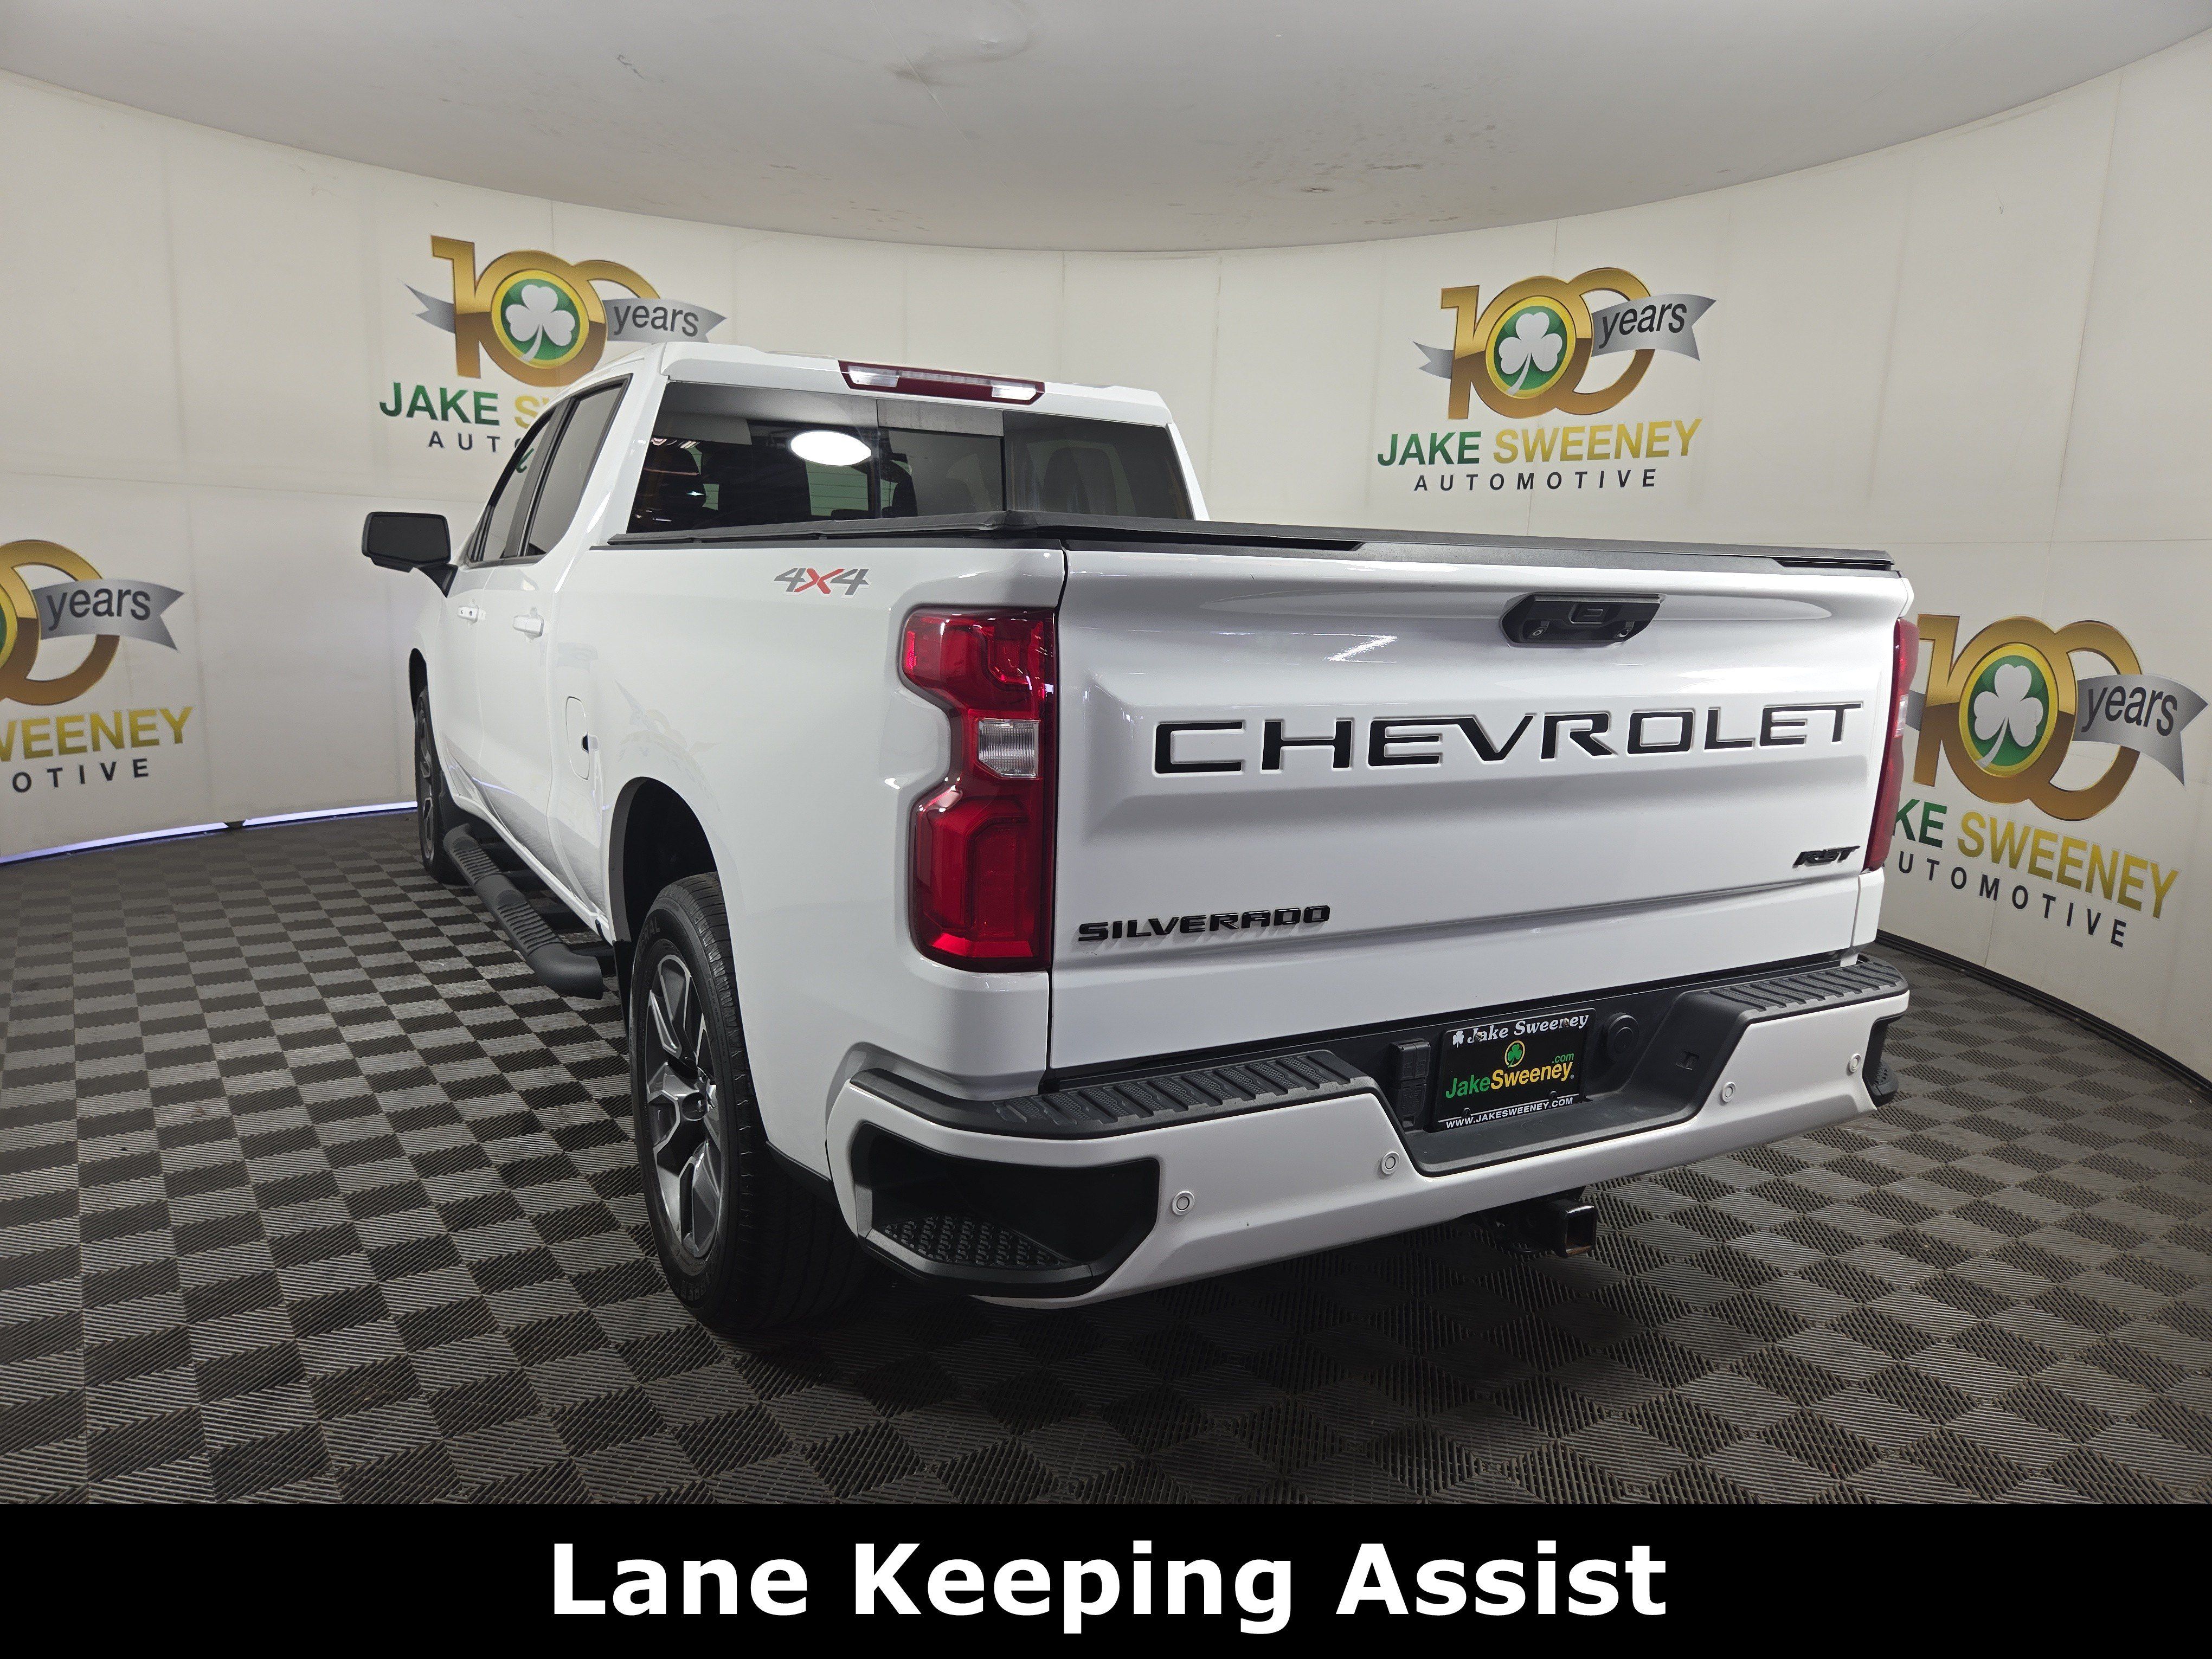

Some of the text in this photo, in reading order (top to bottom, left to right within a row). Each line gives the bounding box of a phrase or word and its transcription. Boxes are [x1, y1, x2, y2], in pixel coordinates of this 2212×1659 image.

[613, 303, 699, 337] years
[1599, 302, 1687, 349] years
[379, 381, 500, 426] JAKE
[1378, 417, 1703, 466] JAKE SWEENEY
[1414, 468, 1656, 491] AUTOMOTIVE
[46, 588, 151, 632] years
[2081, 683, 2178, 737] years
[0, 706, 194, 761] EENEY
[1154, 703, 1863, 775] CHEVROLET
[12, 758, 149, 793] OTIVE
[1792, 845, 1861, 869] RST
[1892, 798, 2181, 920] KE SWEENEY
[1881, 851, 2127, 948] UTOMOTIVE
[1078, 904, 1330, 942] SILVERADO
[1467, 1014, 1589, 1044] Jake Sweeney
[1446, 1097, 1573, 1129] WWW.JAKESWEENEY.COM
